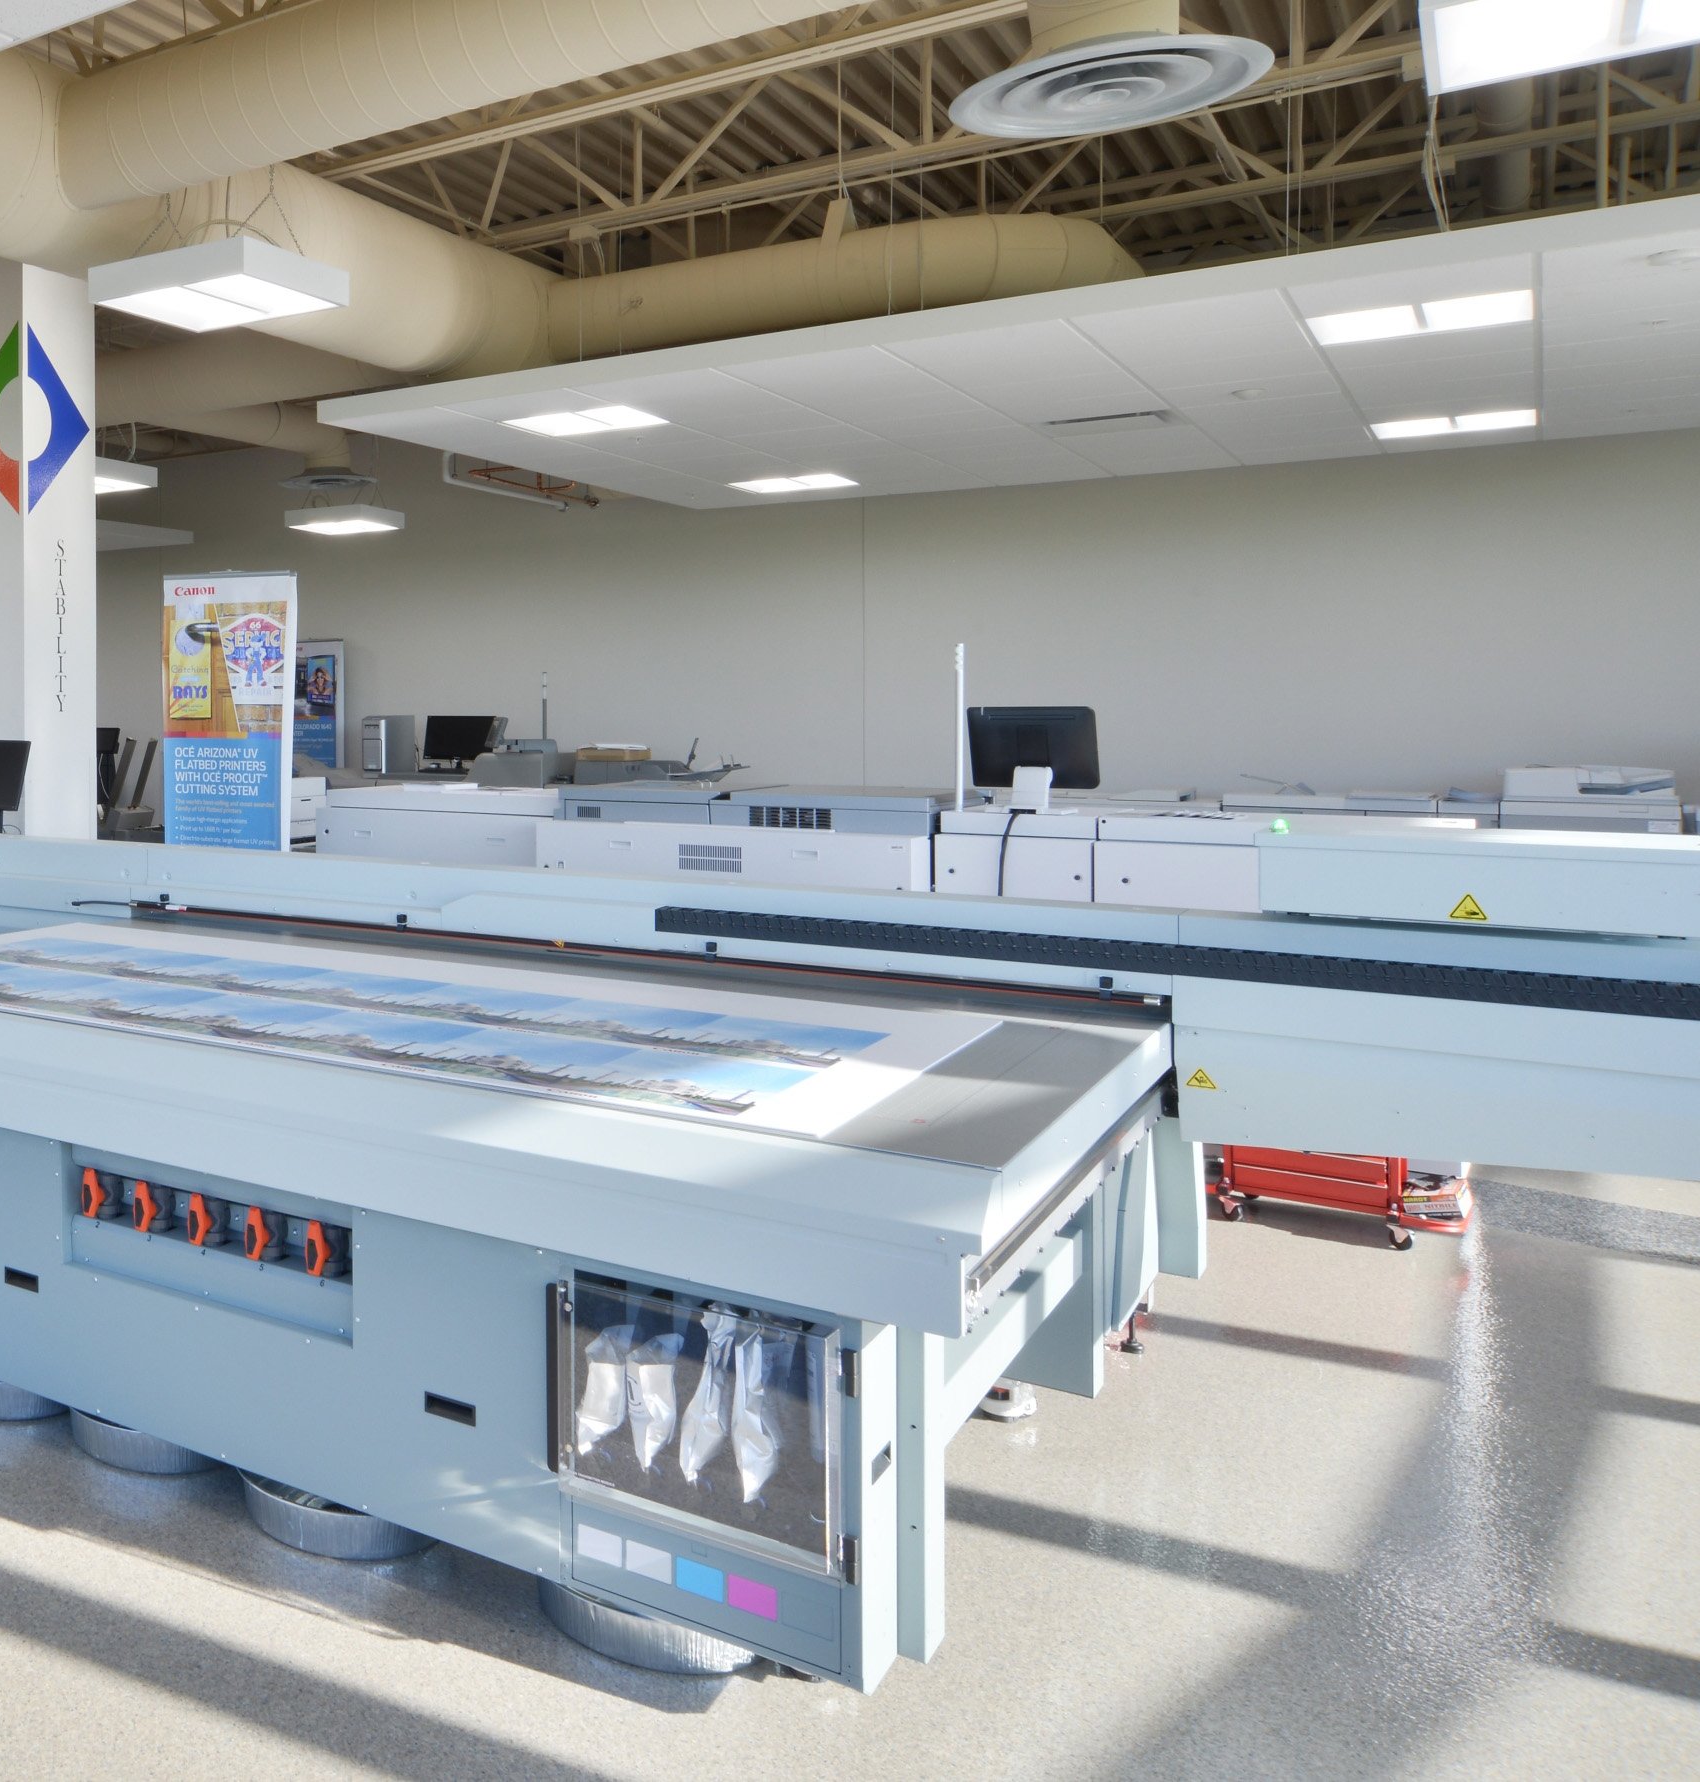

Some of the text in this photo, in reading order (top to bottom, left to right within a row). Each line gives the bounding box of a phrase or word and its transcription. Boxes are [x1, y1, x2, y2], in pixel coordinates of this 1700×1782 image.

[174, 586, 215, 597] Canon
[54, 539, 67, 712] STABILITY
[249, 621, 261, 630] 66
[171, 665, 209, 675] Catching
[173, 685, 208, 699] RAYS
[174, 746, 195, 758] OCÉ
[243, 748, 259, 759] UV
[175, 759, 267, 772] FLATBED PRINTERS
[175, 771, 200, 782] WITH
[202, 771, 221, 782] OCÉ
[175, 784, 259, 796] CUTTING SYSTEM
[95, 1220, 100, 1228] 2
[200, 1248, 206, 1256] 4
[259, 1263, 264, 1271] 5
[320, 1279, 325, 1287] 6
